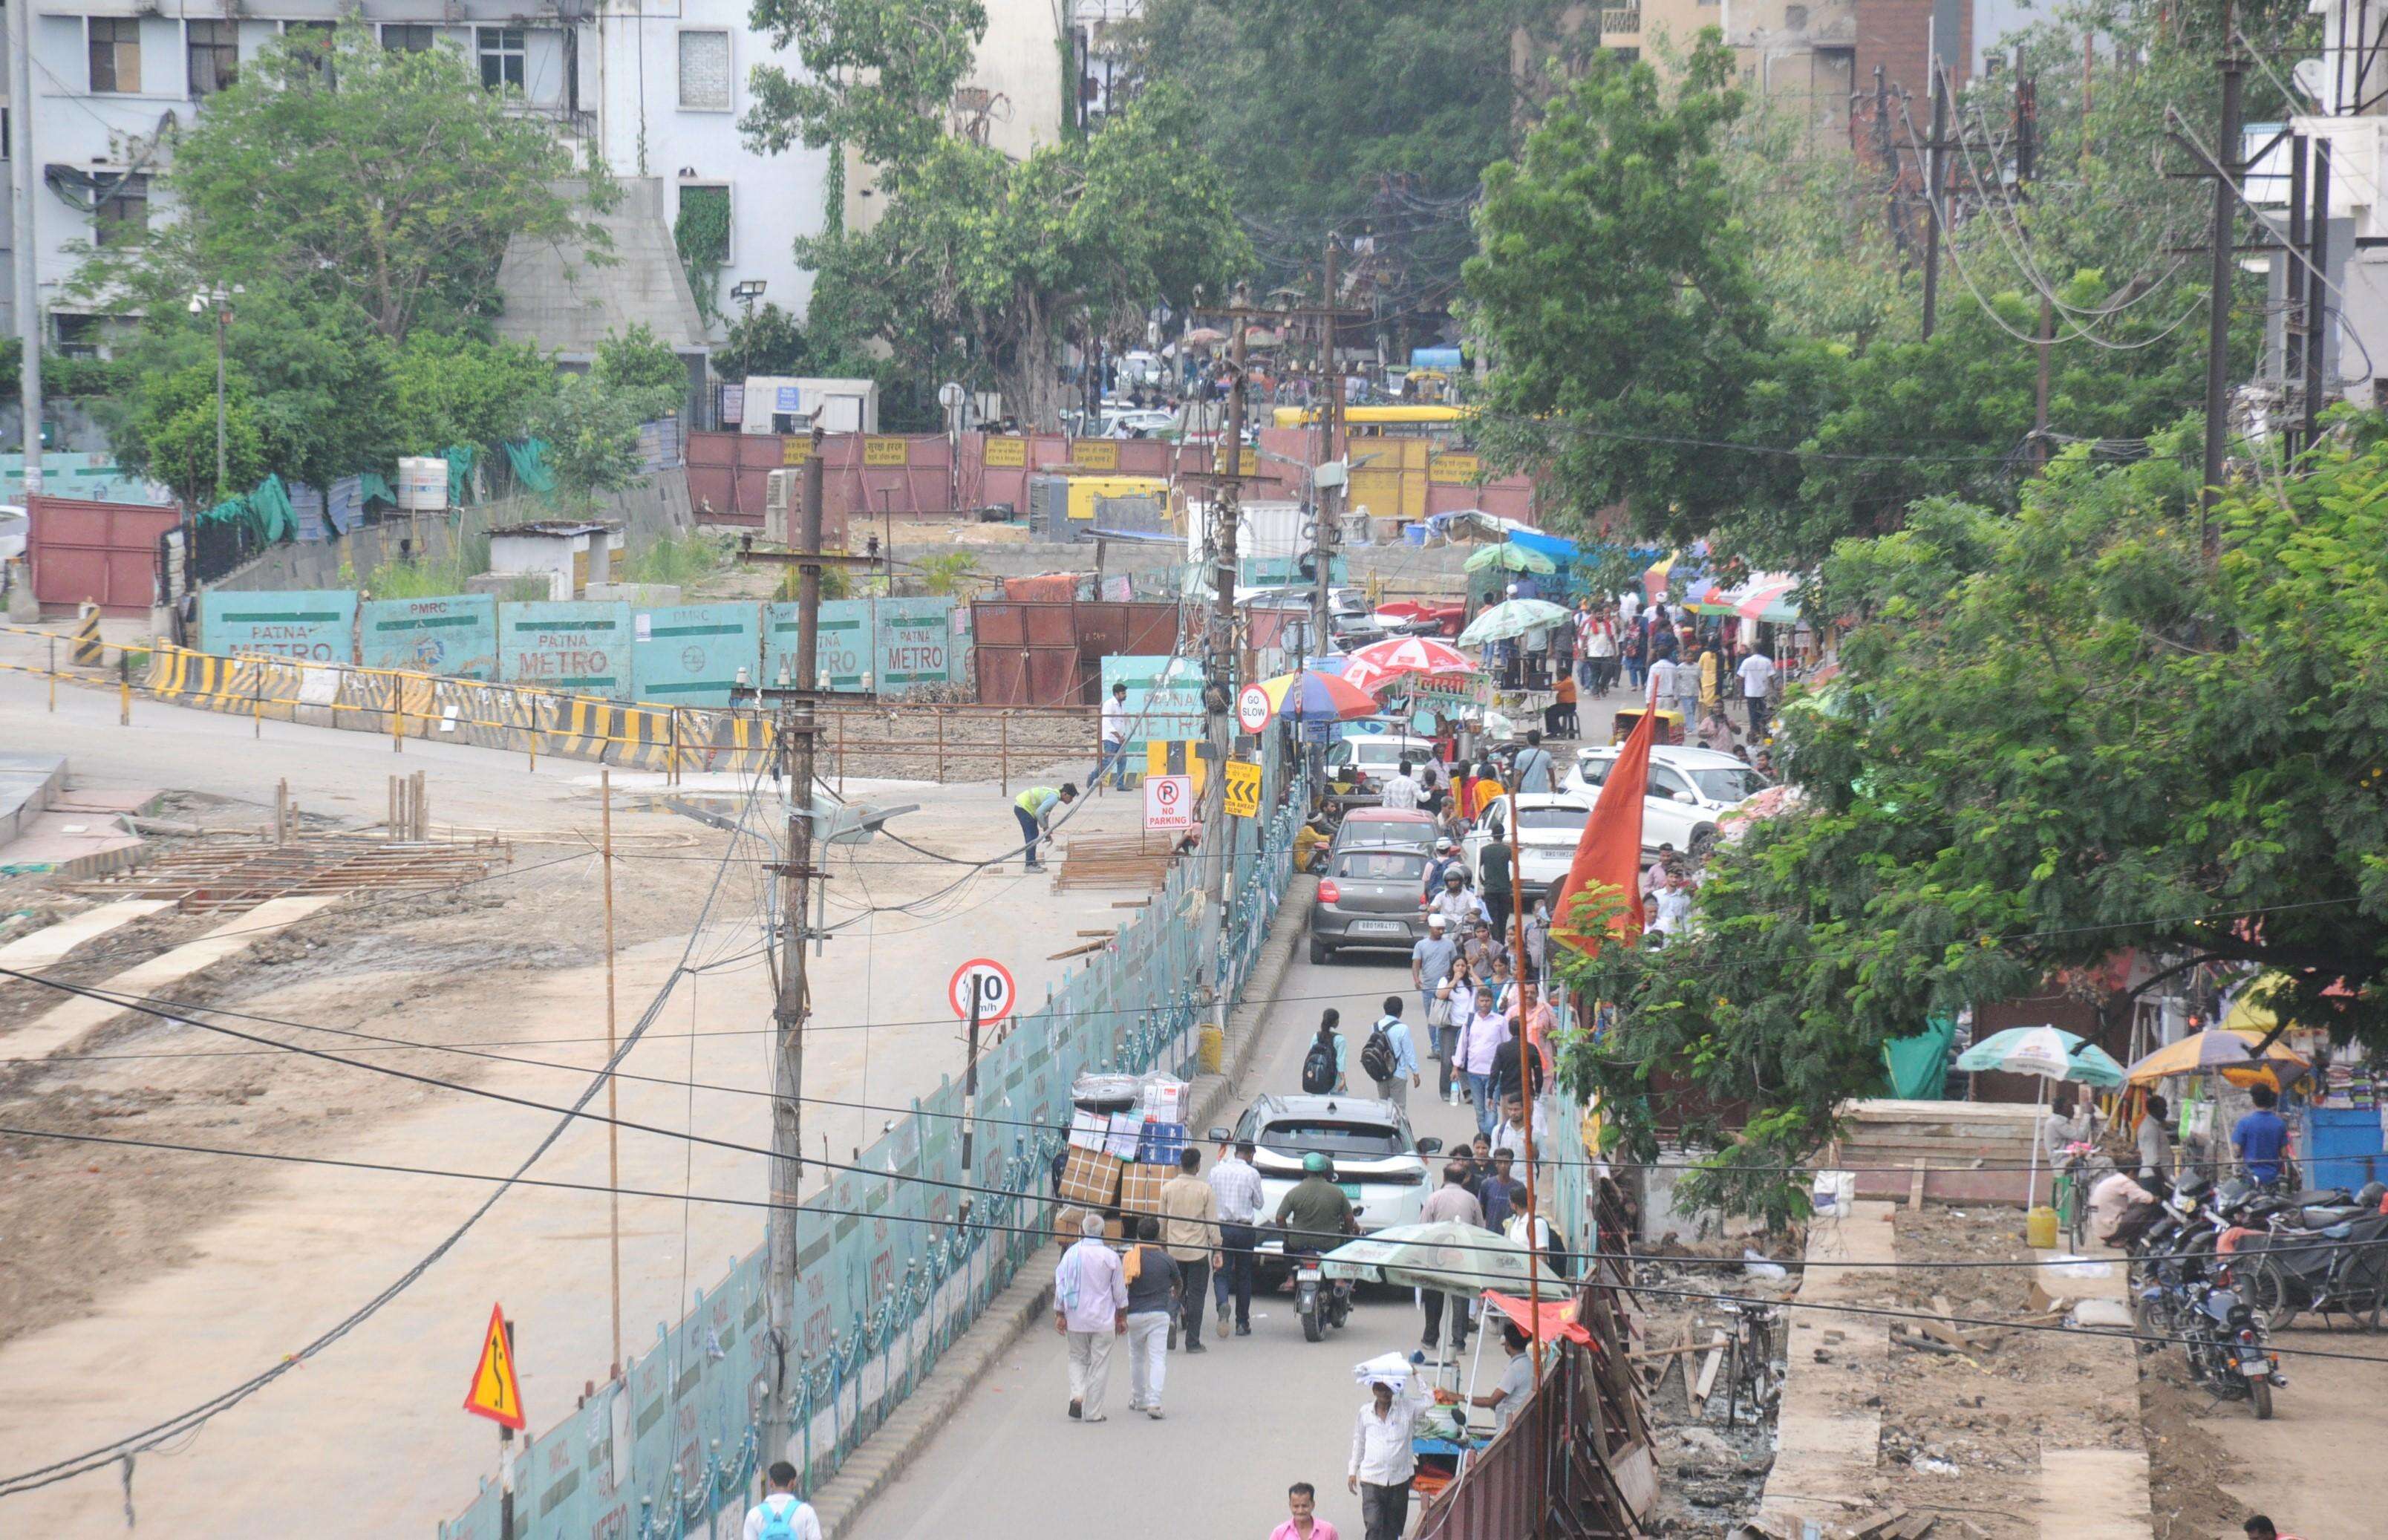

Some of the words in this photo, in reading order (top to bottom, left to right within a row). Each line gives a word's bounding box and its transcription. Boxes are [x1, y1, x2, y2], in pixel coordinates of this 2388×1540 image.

[411, 602, 447, 614] PMRC
[252, 626, 307, 639] PATNA
[900, 630, 930, 642] PATNA
[539, 635, 587, 647] PATNA
[817, 635, 841, 648] TNA
[518, 650, 607, 675] METRO
[780, 650, 856, 675] MTRO
[889, 647, 943, 669] METRO
[1247, 695, 1260, 705] GO
[1242, 707, 1265, 717] SLOW
[1123, 712, 1203, 737] METR
[1162, 807, 1174, 815] NO
[1237, 802, 1255, 810] AHEAD
[1149, 817, 1187, 826] PARKING
[979, 1003, 997, 1012] m/h
